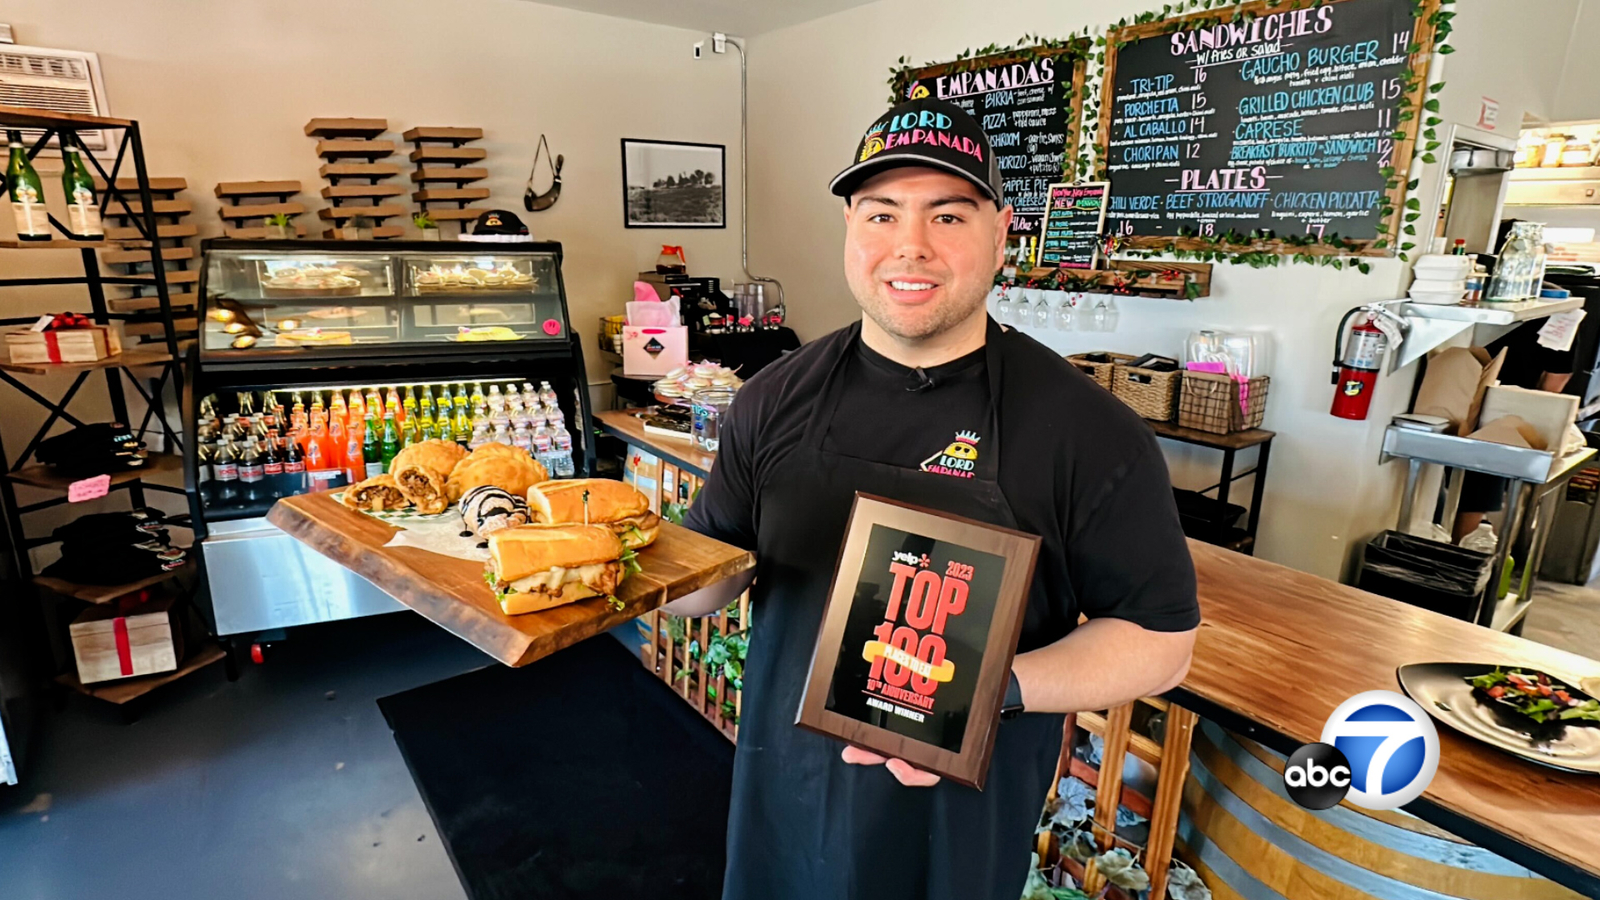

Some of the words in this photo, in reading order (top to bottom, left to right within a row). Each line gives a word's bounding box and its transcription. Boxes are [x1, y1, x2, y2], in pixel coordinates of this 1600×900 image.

[1171, 5, 1333, 55] SANDWICHES
[1241, 52, 1300, 81] GAUCHO
[1307, 40, 1379, 67] BURGER
[1392, 30, 1410, 54] 14
[936, 57, 1054, 98] EMPANADAS
[1130, 74, 1174, 94] TRI-TIP
[1194, 68, 1207, 84] 16
[985, 90, 1014, 108] BIRRIA
[1125, 98, 1178, 117] PORCHETTA
[1192, 92, 1206, 109] 15
[1238, 91, 1289, 115] GRILLED
[1291, 86, 1343, 109] CHICKEN
[1343, 81, 1375, 101] CLUB
[1381, 78, 1401, 100] 15
[889, 110, 952, 133] LORD
[983, 112, 1007, 131] PIZZA
[1124, 127, 1137, 138] AL
[1139, 120, 1186, 137] CABALLO
[1190, 116, 1205, 134] 14
[1235, 119, 1304, 139] CAPRESE
[1377, 108, 1390, 128] 11
[885, 128, 983, 163] EMPANADA
[1124, 145, 1178, 162] CHORIPAN
[1186, 143, 1200, 159] 12
[1231, 143, 1276, 160] BREAKFAST
[1278, 141, 1318, 157] BURRITO
[1324, 139, 1376, 154] SANDWICH
[996, 154, 1027, 169] HORIZO
[1004, 179, 1031, 192] APPLE
[1034, 178, 1048, 190] PIE
[1181, 166, 1267, 190] PLATES
[1014, 196, 1047, 207] CHEESECA
[1129, 195, 1160, 210] VERDE
[1166, 194, 1196, 209] BEEF
[1197, 192, 1271, 209] STROGANOFF
[1274, 192, 1327, 209] CHICKEN
[1120, 220, 1134, 235] 16
[1199, 223, 1214, 237] 18
[1306, 224, 1325, 239] 17
[939, 455, 975, 471] LORD
[892, 551, 919, 565] yelp
[945, 560, 975, 581] 2023
[885, 561, 970, 636] TOP
[868, 621, 947, 696] 100
[881, 683, 935, 709] ANNIVERSARY
[866, 697, 894, 713] AWARD
[894, 705, 925, 723] WINNER
